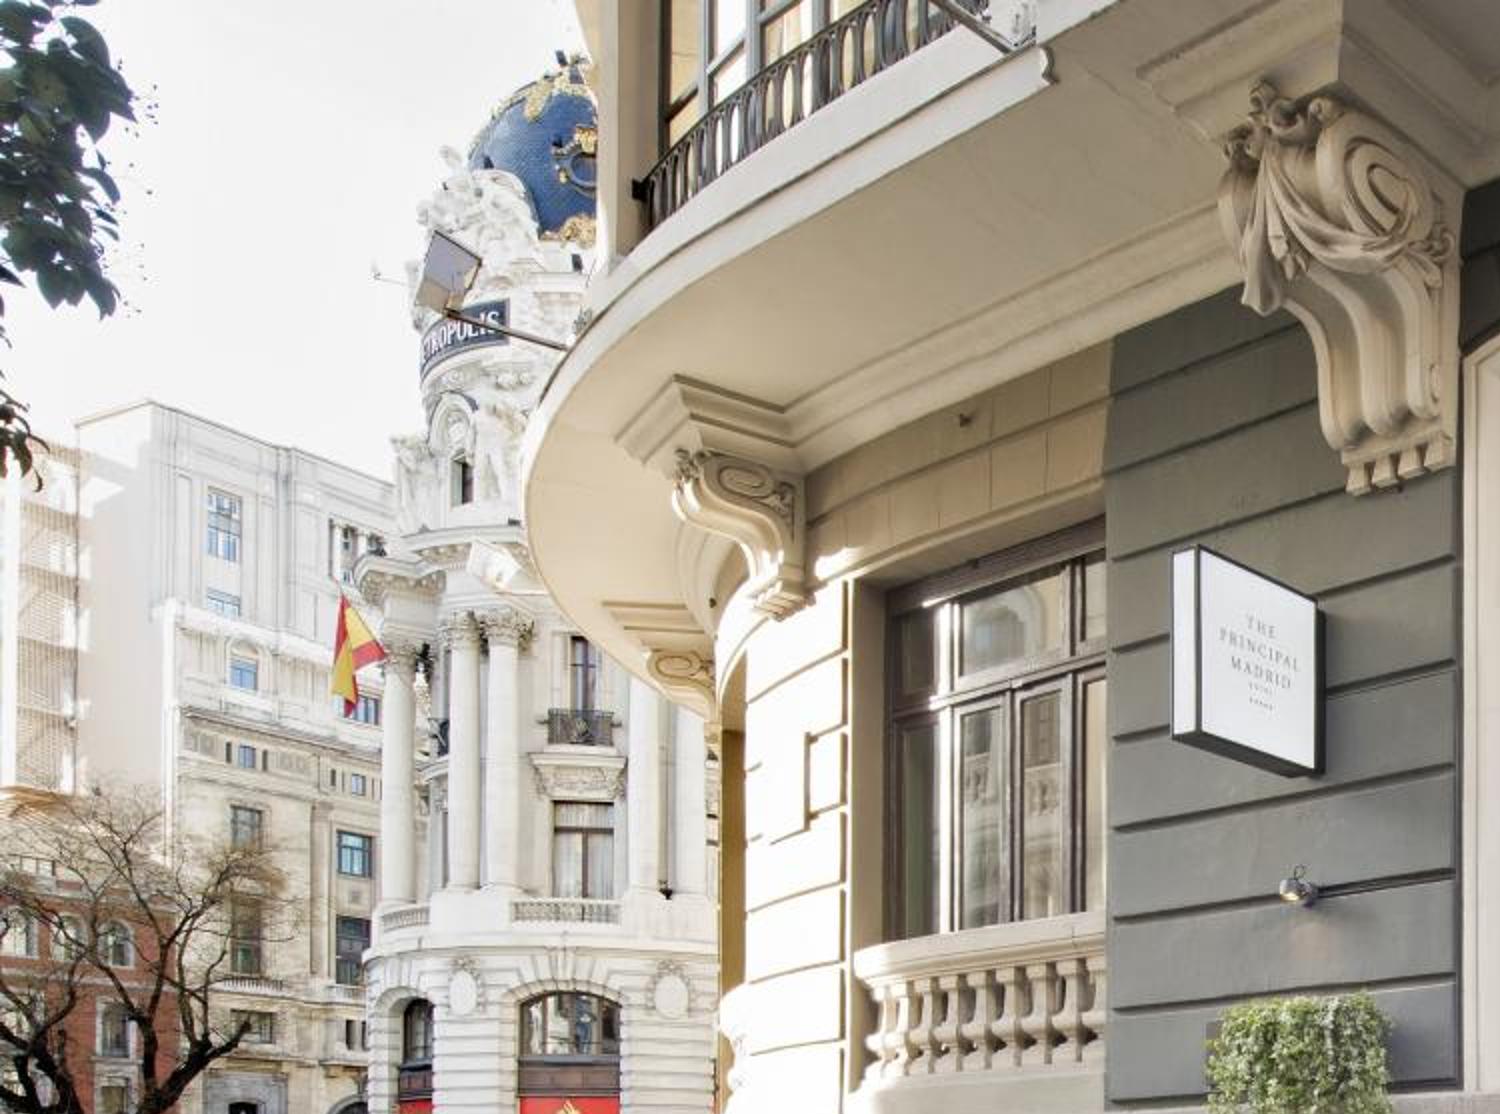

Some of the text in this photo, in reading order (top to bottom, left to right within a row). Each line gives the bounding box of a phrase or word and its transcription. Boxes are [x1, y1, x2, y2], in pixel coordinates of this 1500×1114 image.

[1246, 612, 1276, 640] THE
[1219, 627, 1301, 673] PRINCIPAL
[1231, 655, 1291, 690] MADRID
